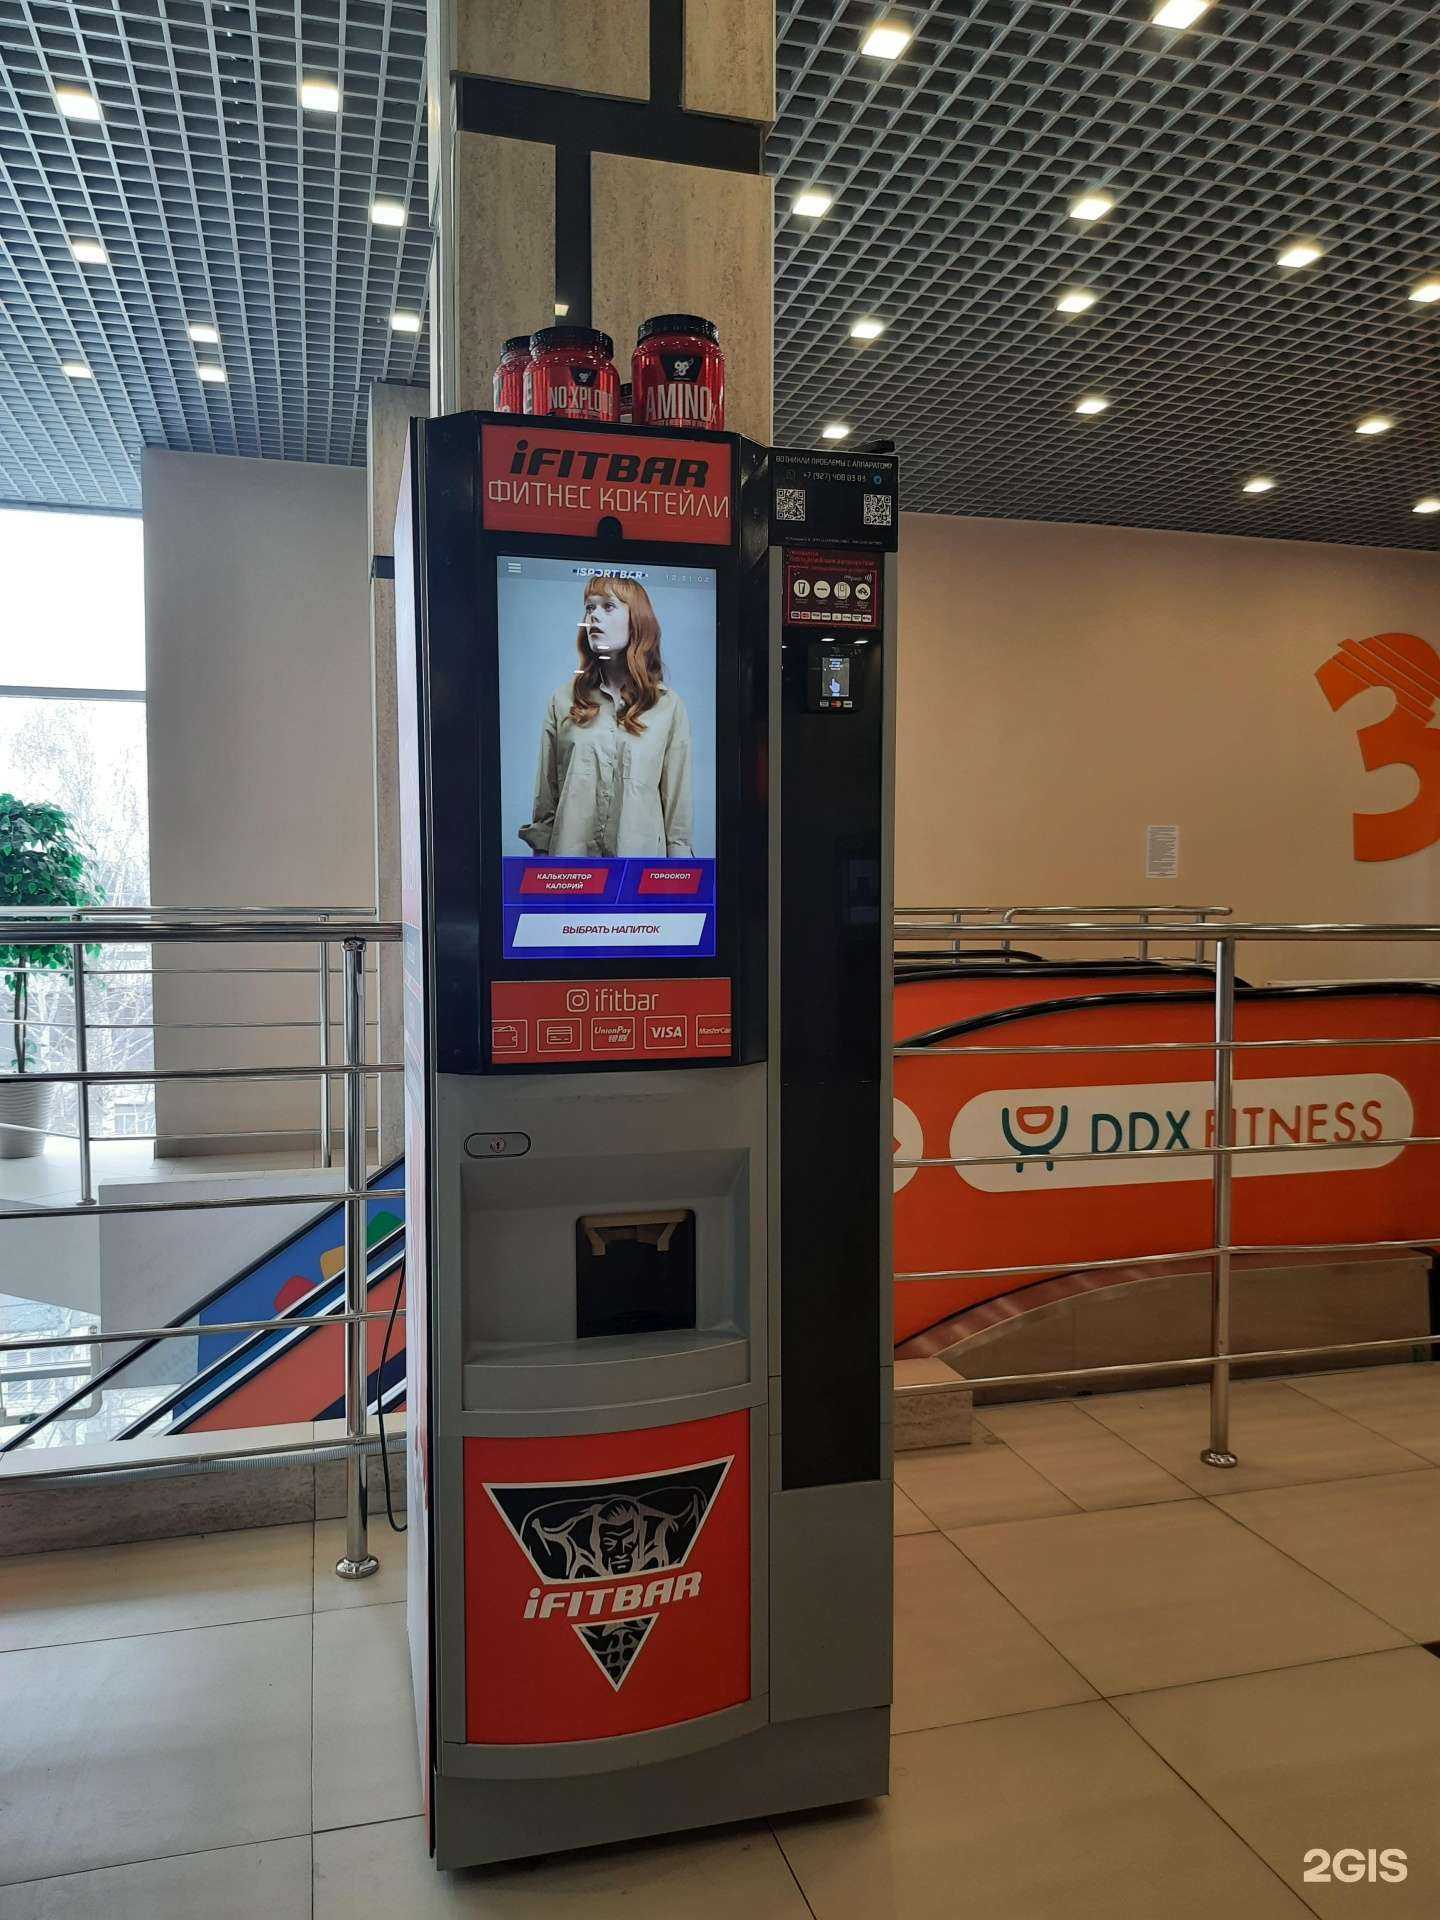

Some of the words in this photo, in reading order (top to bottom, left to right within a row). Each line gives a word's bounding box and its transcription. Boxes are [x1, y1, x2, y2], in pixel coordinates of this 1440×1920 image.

[510, 439, 709, 488] iFITBAR
[811, 458, 846, 468] ПРОБЛЕМЫ
[488, 479, 592, 509] ФИТНЕС
[600, 487, 730, 519] КОКТЕЙЛИ
[536, 872, 593, 881] КАЛЬКУЛЯТОР
[649, 872, 691, 880] ГОРОСКОП
[545, 881, 584, 890] КАЛОРИЙ
[562, 925, 610, 935] ВЫБРАТЬ
[611, 925, 661, 935] НАПИТОК
[595, 988, 660, 1012] ifitbar
[594, 1025, 632, 1038] UnionPay
[651, 1025, 682, 1039] VISA
[1091, 1109, 1191, 1153] DDX
[523, 1570, 702, 1620] iFITBAR
